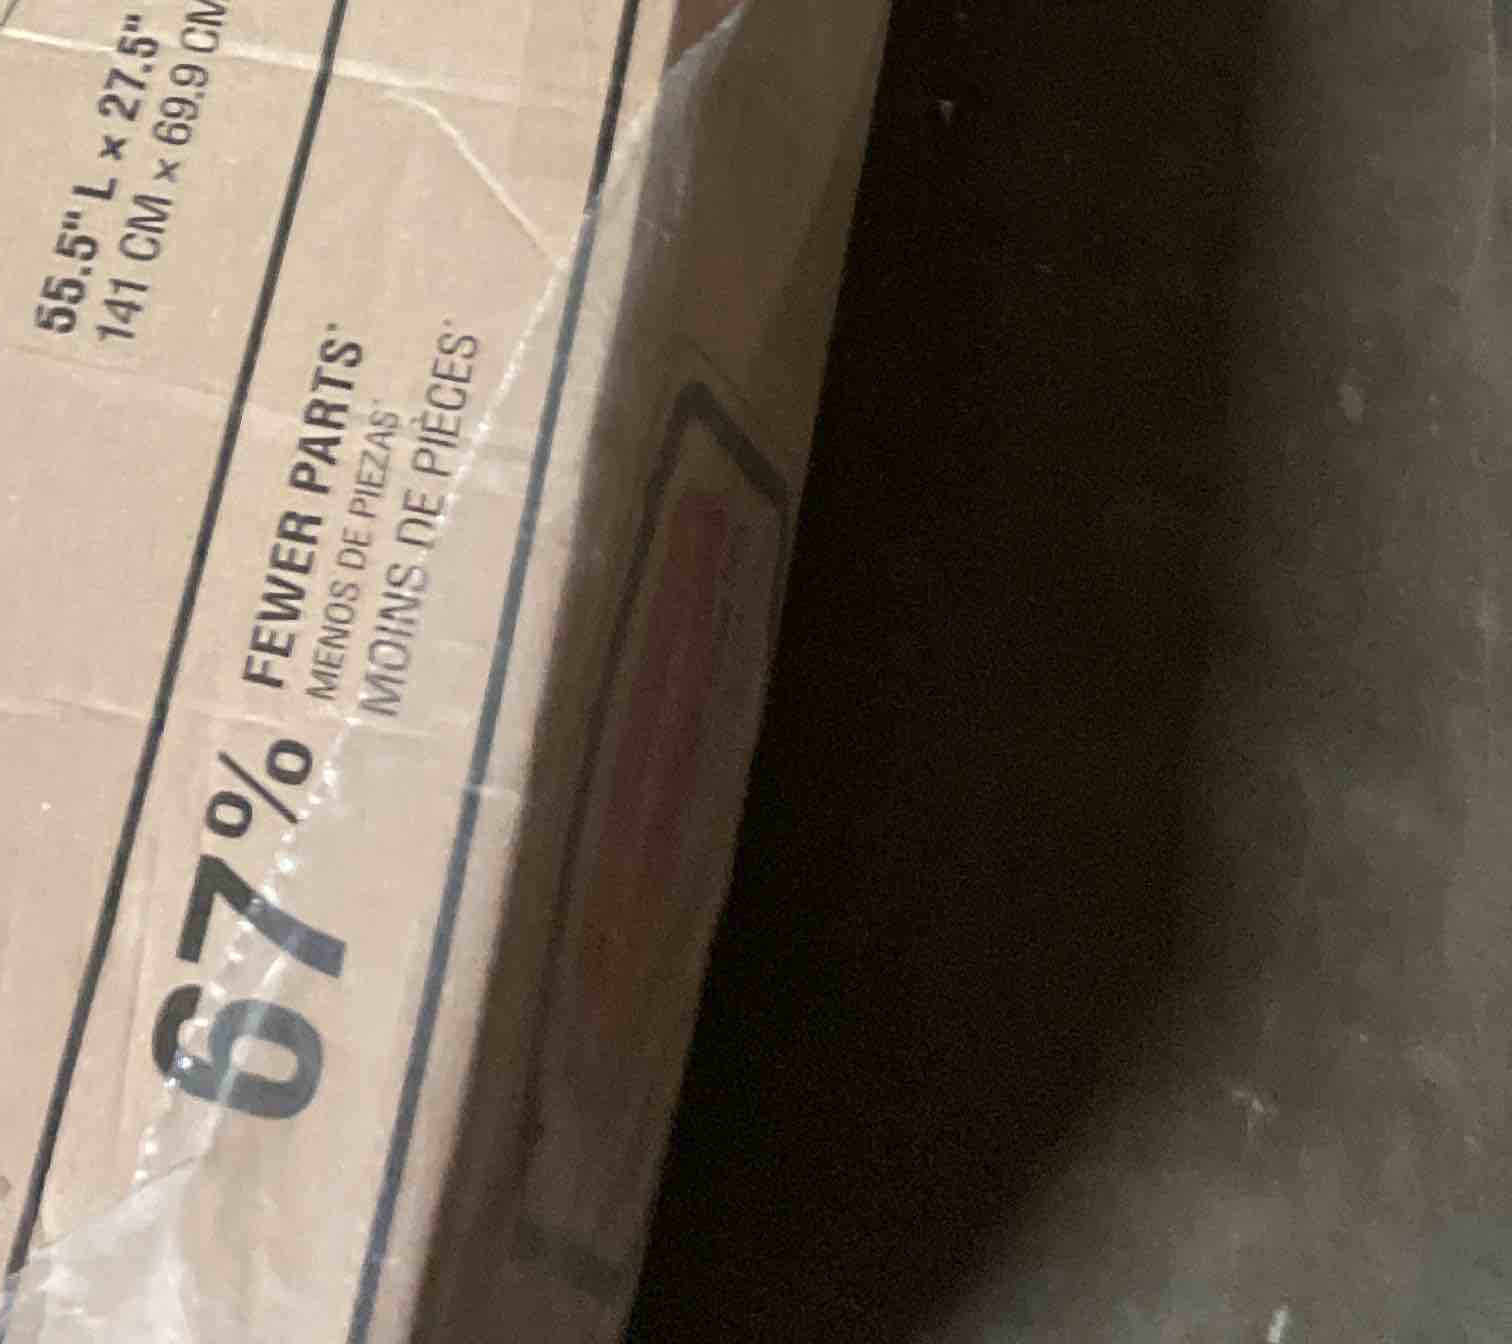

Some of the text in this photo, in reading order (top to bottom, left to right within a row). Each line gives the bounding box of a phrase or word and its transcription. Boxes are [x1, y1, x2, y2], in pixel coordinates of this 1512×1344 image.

[34, 210, 99, 336] 55.5"
[72, 176, 118, 202] L
[98, 14, 160, 124] 27.5"
[151, 62, 210, 149] 69.9
[96, 277, 151, 344] 141
[118, 193, 174, 263] CM
[241, 507, 325, 692] FEWER
[302, 576, 365, 703] MENOS
[335, 519, 372, 572] DE
[356, 562, 431, 718] MOINS
[395, 494, 447, 555] DE
